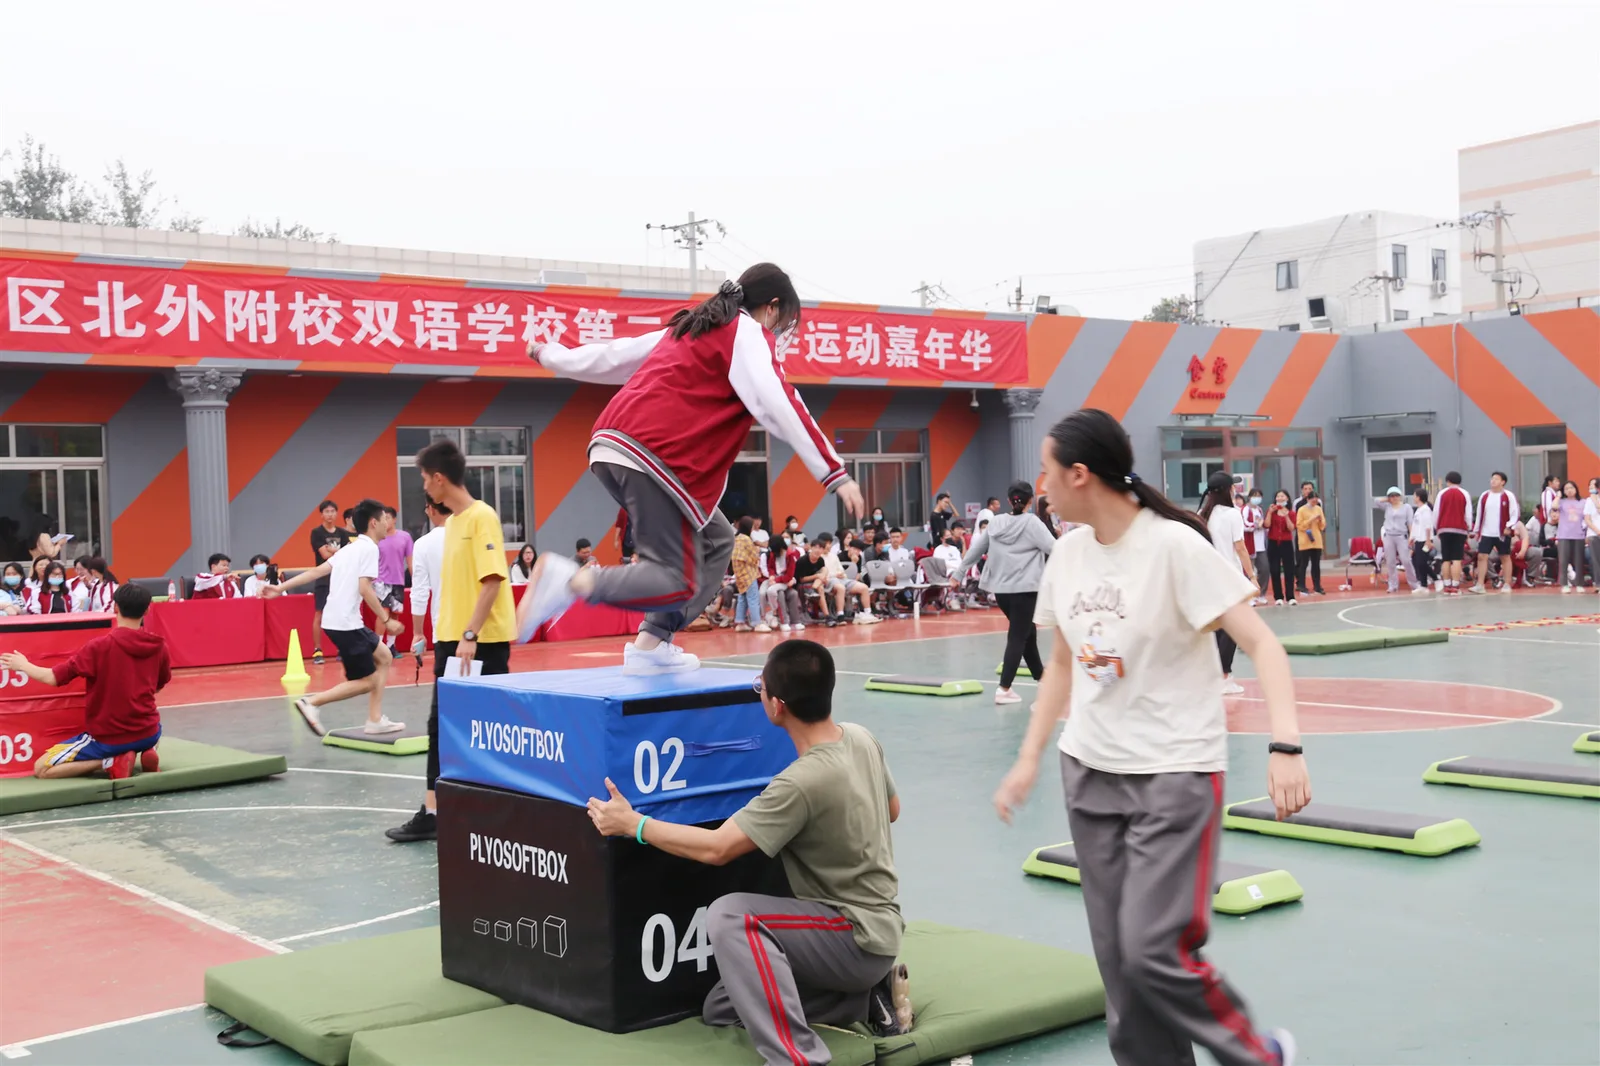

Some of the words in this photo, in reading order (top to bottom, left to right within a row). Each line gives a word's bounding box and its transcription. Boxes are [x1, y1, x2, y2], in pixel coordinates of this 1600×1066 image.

[0, 732, 34, 764] 03
[470, 719, 565, 763] PLYOSOFTBOX
[633, 736, 687, 794] 02
[469, 832, 569, 884] PLYOSOFTBOX
[641, 905, 715, 983] 04
